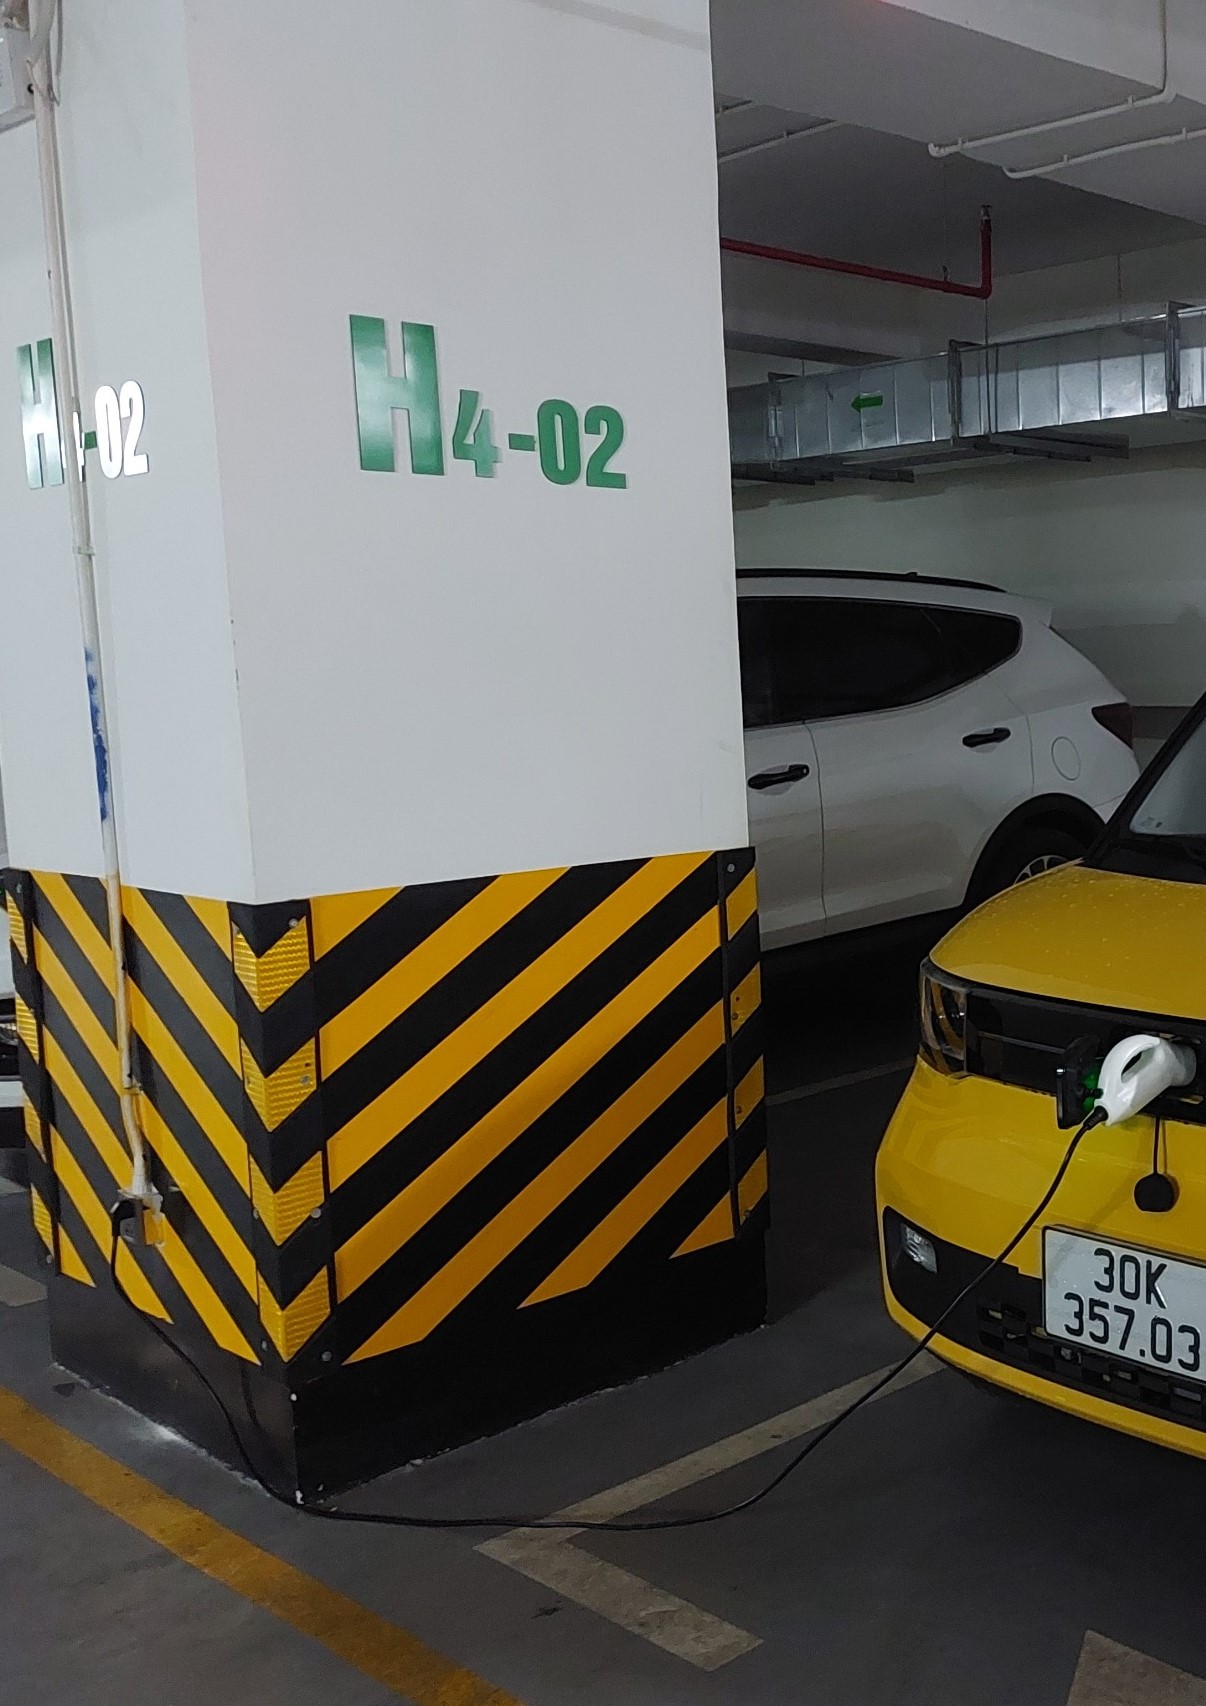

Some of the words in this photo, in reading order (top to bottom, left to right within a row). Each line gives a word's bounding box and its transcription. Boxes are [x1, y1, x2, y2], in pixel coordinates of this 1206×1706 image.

[349, 314, 627, 490] H4-02
[1093, 1247, 1169, 1310] 30K
[1064, 1292, 1201, 1372] 357.03
